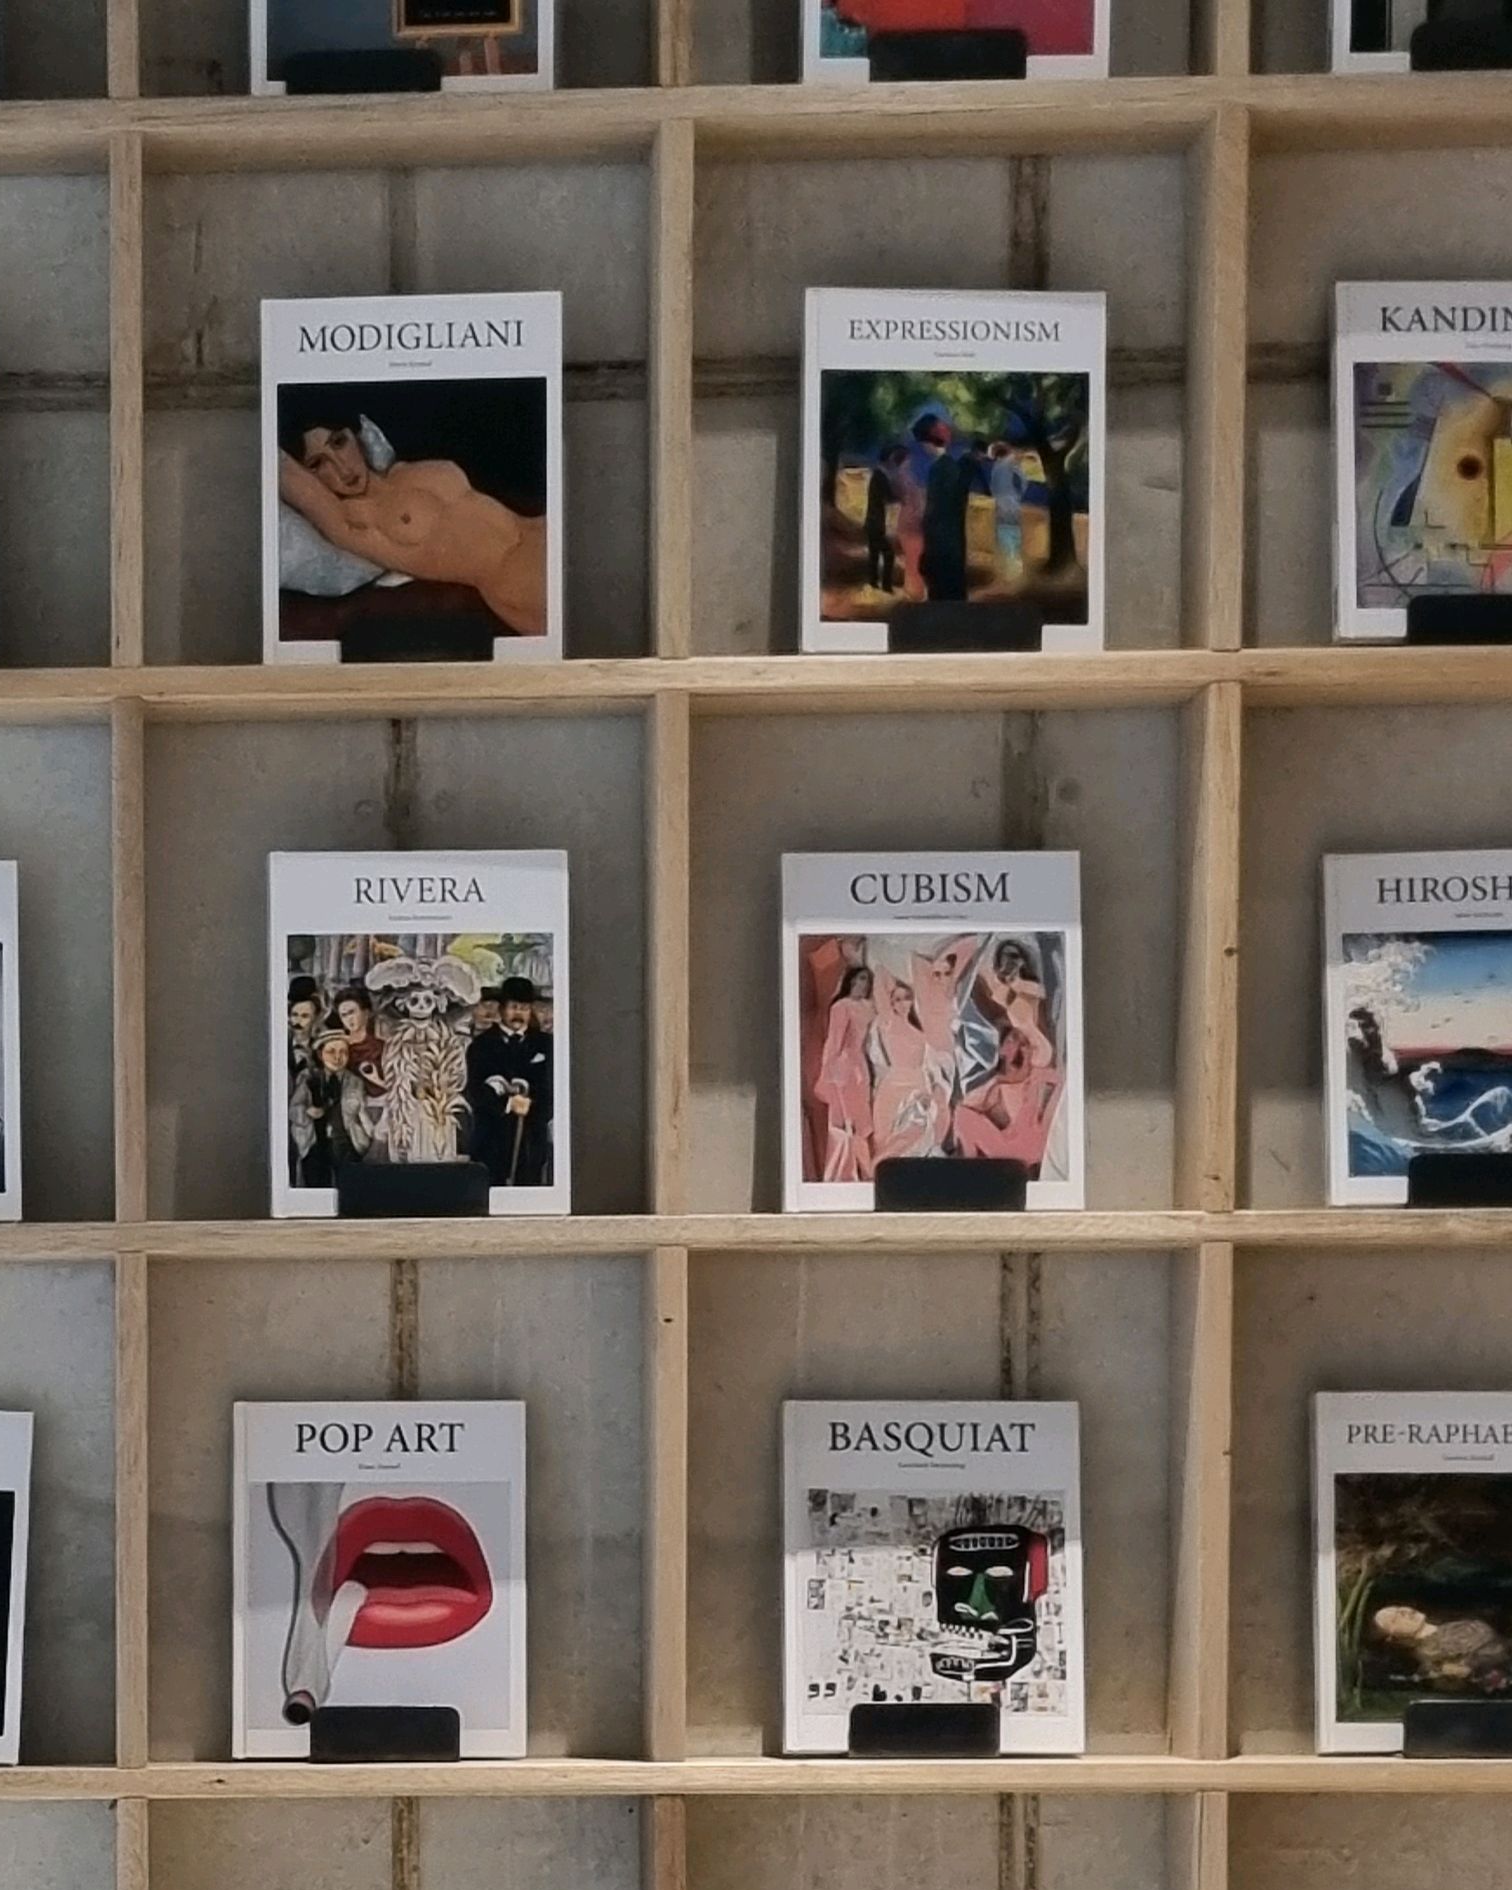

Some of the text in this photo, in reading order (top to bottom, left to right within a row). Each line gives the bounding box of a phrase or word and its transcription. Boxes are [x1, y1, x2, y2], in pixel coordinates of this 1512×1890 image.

[297, 319, 523, 353] MODIGLIANI
[848, 318, 1060, 342] EXPRESSIONISM
[354, 876, 486, 905] RIVERA
[849, 872, 1010, 905] CUBISM
[1376, 874, 1512, 905] HIROSH
[295, 1421, 466, 1454] POP ART
[828, 1421, 1036, 1459] BASQUIAT
